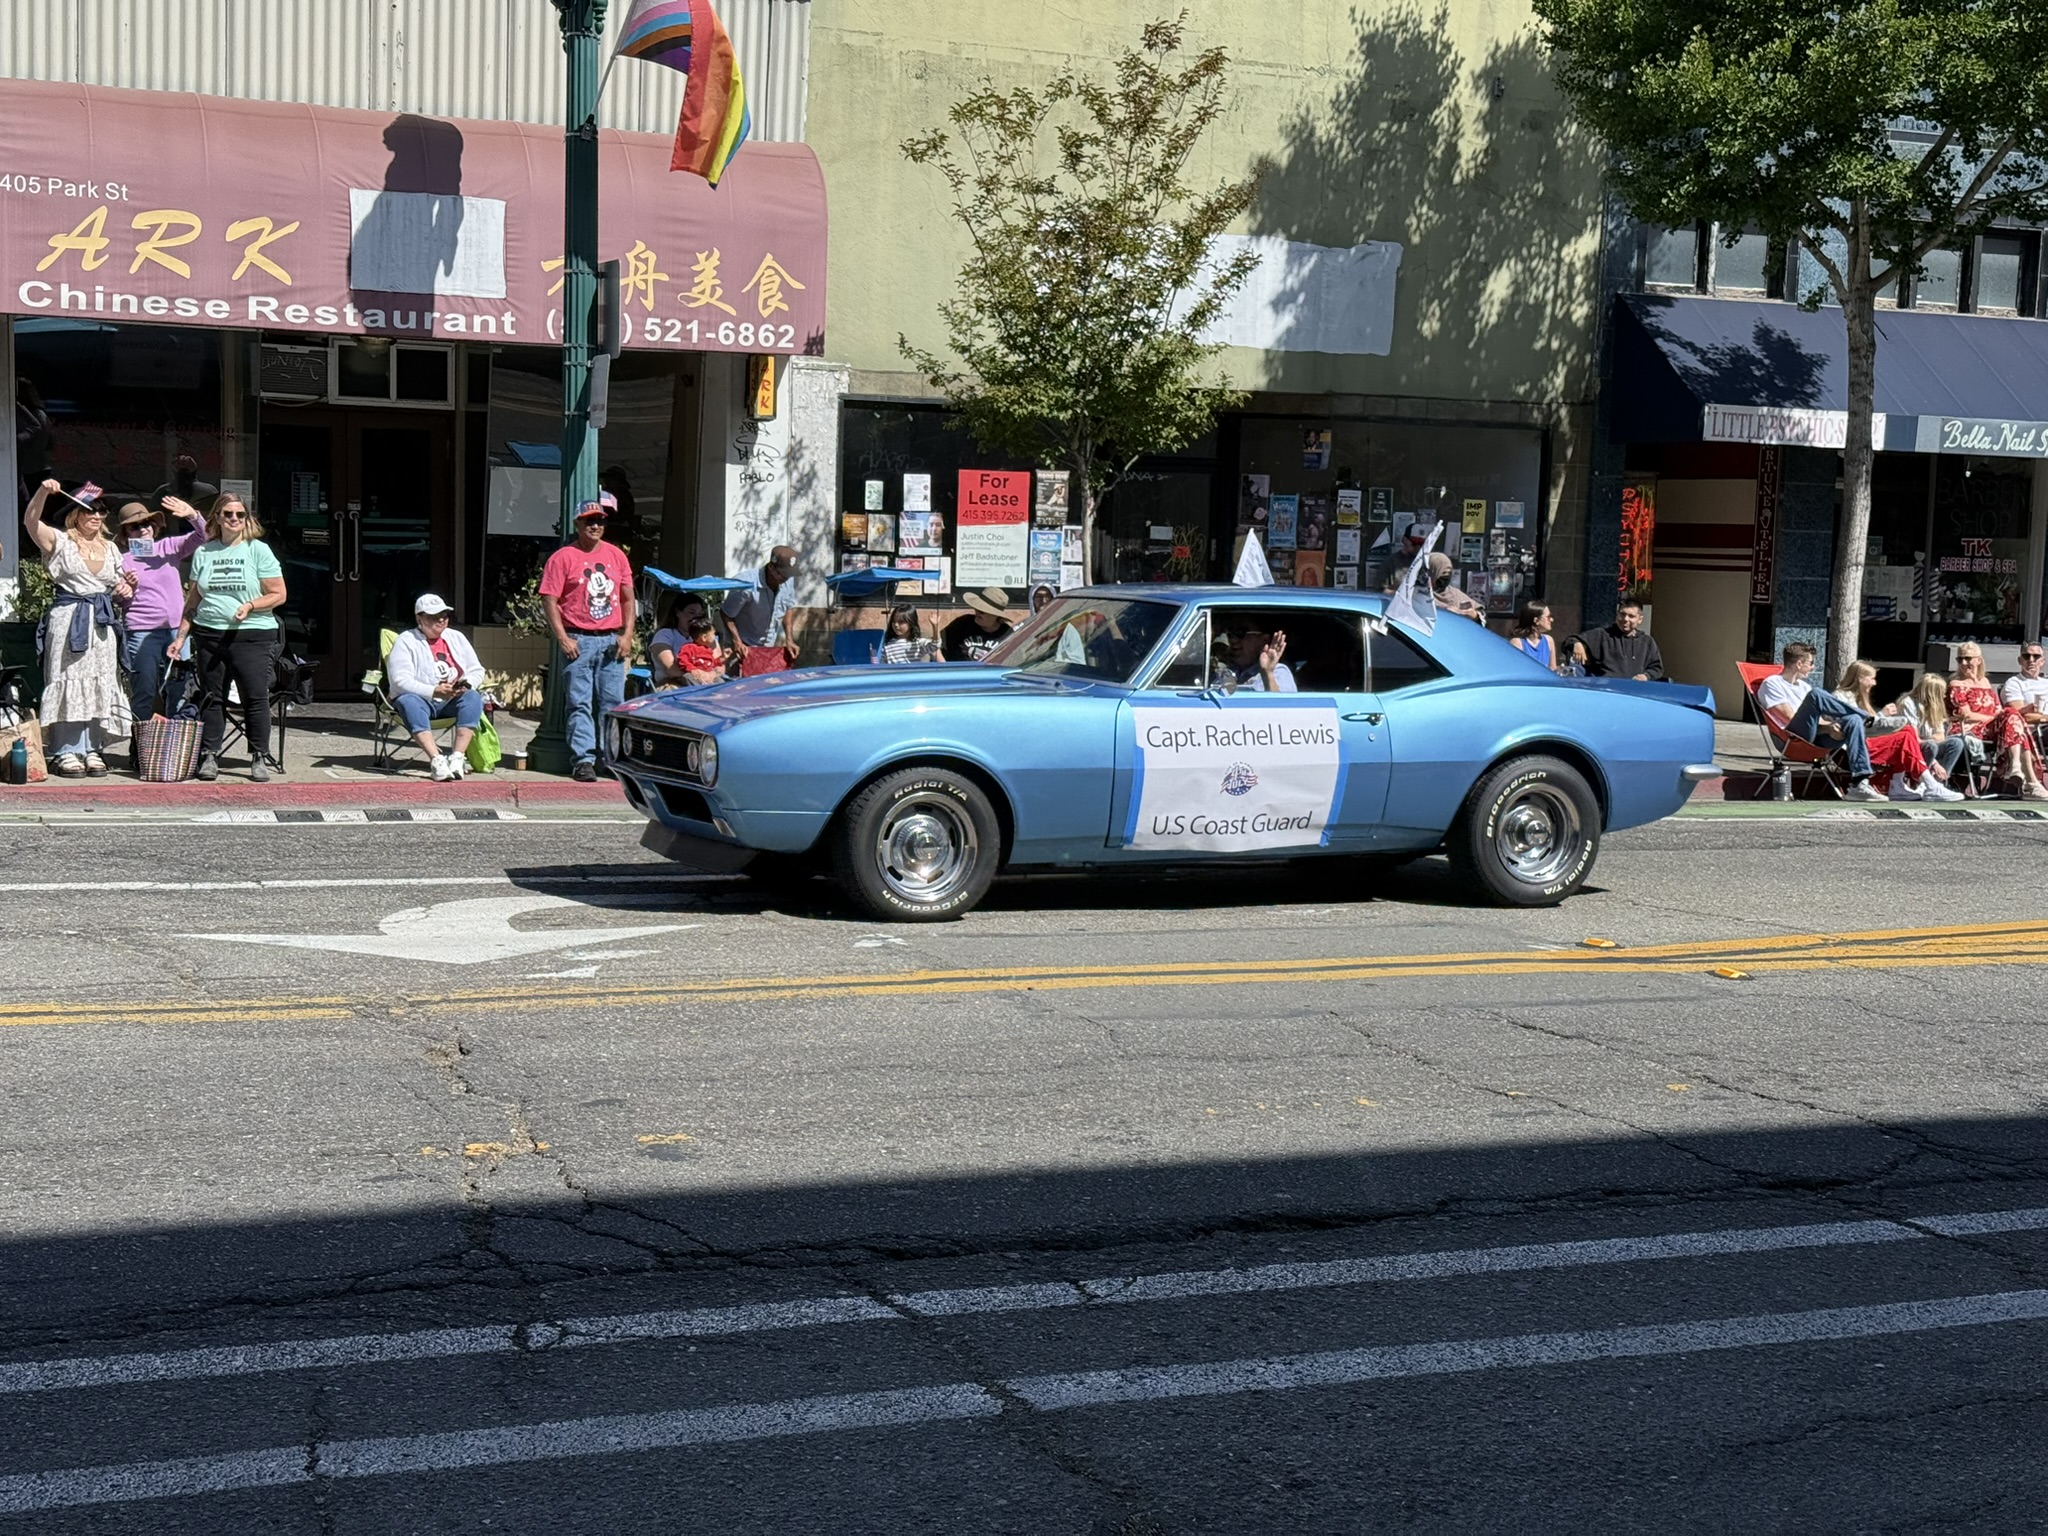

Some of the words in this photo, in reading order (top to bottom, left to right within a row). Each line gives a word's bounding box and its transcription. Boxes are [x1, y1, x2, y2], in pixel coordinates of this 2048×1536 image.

[48, 178, 99, 199] Park
[105, 182, 129, 201] St
[36, 205, 300, 286] ARK
[18, 281, 231, 319] Chinese
[247, 296, 517, 335] Restaurant
[644, 318, 795, 348] 521-6862
[1711, 411, 1767, 440] LITTLE
[1943, 420, 1992, 449] Bella
[1992, 423, 2036, 451] Nail
[980, 474, 1010, 489] For
[1762, 445, 1776, 506] RTUNE
[968, 490, 1020, 506] Lease
[1466, 502, 1483, 510] IMP
[960, 533, 985, 541] Justin
[986, 533, 1005, 541] Choi
[1961, 538, 1993, 557] TK
[960, 553, 975, 561] Jeff
[1757, 530, 1771, 593] TELLER
[1940, 557, 1971, 572] BARBER
[1972, 558, 1994, 573] SHOP
[2002, 560, 2018, 574] SPA
[1146, 725, 1201, 753] Capt.
[1205, 723, 1272, 747] Rachel
[1278, 724, 1335, 745] Lewis
[894, 780, 944, 800] Radial
[948, 785, 968, 801] T/A
[1486, 771, 1547, 838] BFGoodrich
[1152, 815, 1185, 836] U.S
[1190, 815, 1247, 836] Coast
[1251, 811, 1313, 833] Guard
[1565, 840, 1592, 886] Radial
[881, 890, 969, 913] BFGoodrich
[1543, 884, 1564, 895] T/A
